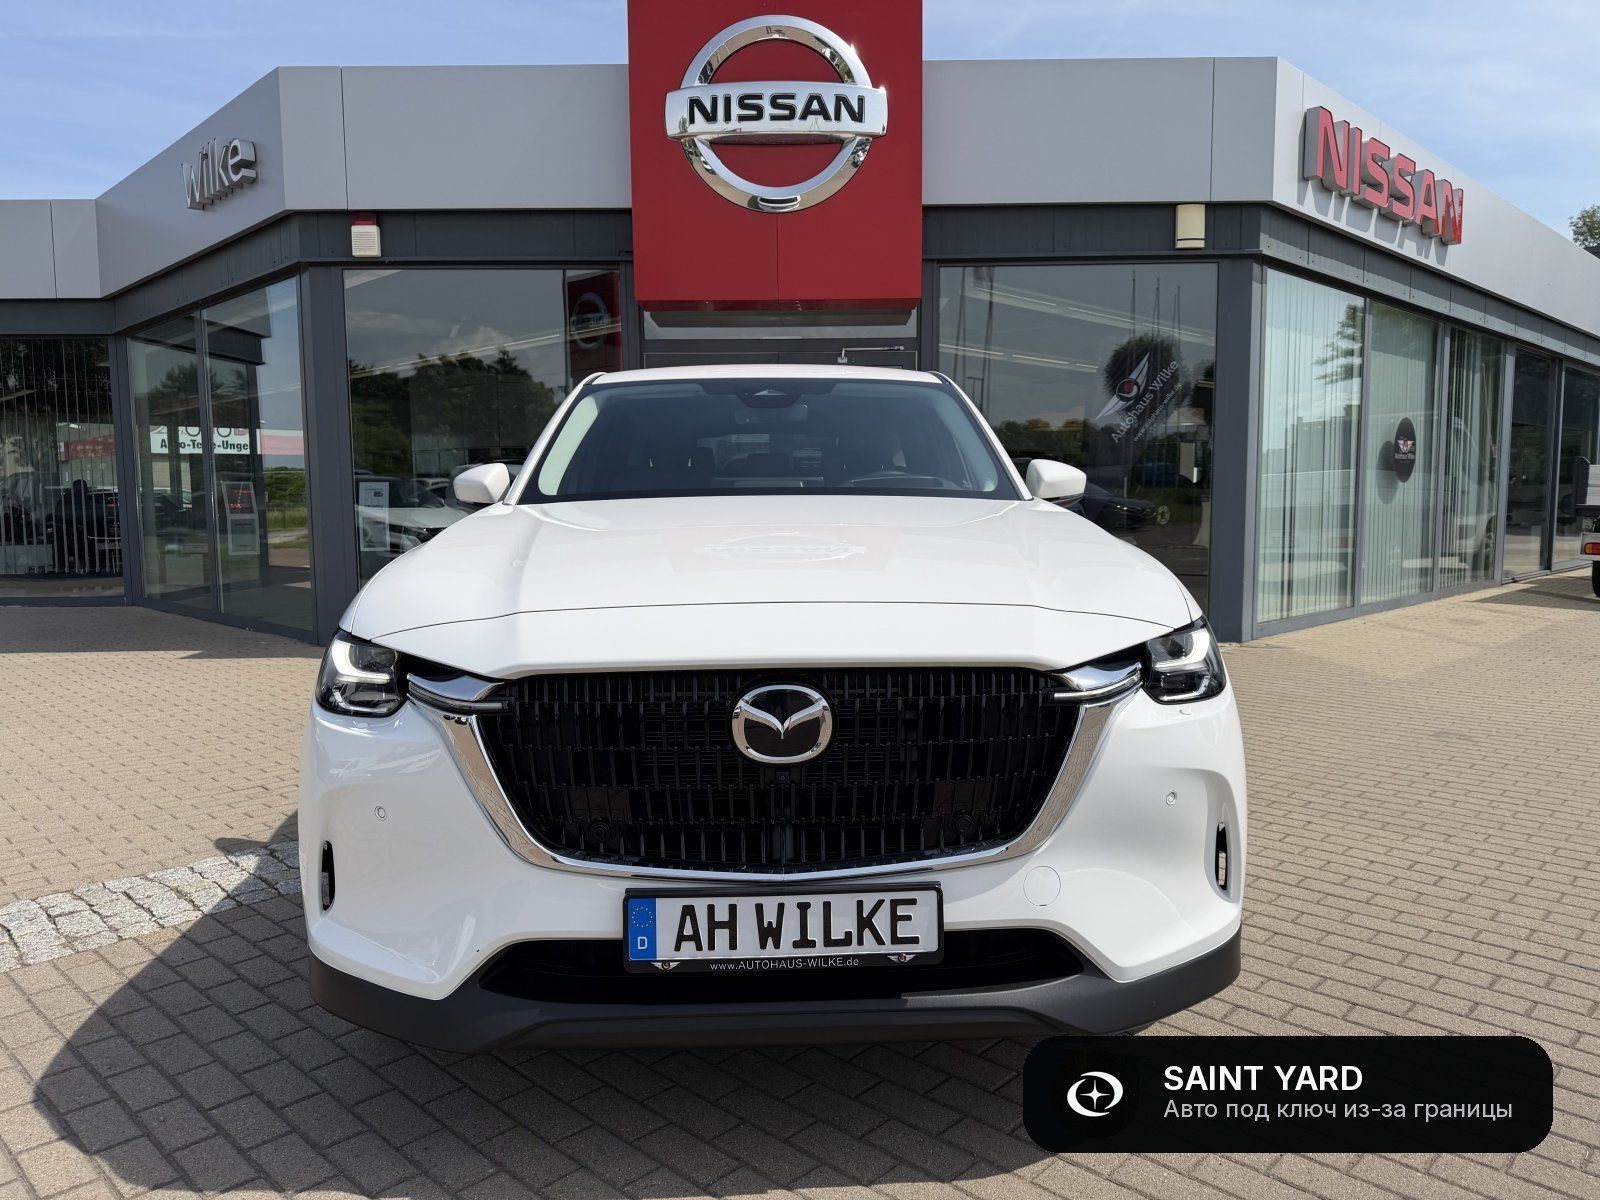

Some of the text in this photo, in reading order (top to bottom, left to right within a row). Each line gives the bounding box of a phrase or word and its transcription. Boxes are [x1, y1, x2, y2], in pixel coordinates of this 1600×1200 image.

[687, 93, 866, 125] NISSAN
[1304, 105, 1464, 245] NISSAN
[1111, 392, 1153, 443] Autohaus
[637, 937, 648, 950] D
[674, 898, 920, 951] AH WILKE
[710, 958, 860, 970] www.AUTOHAUS-WILKE.de
